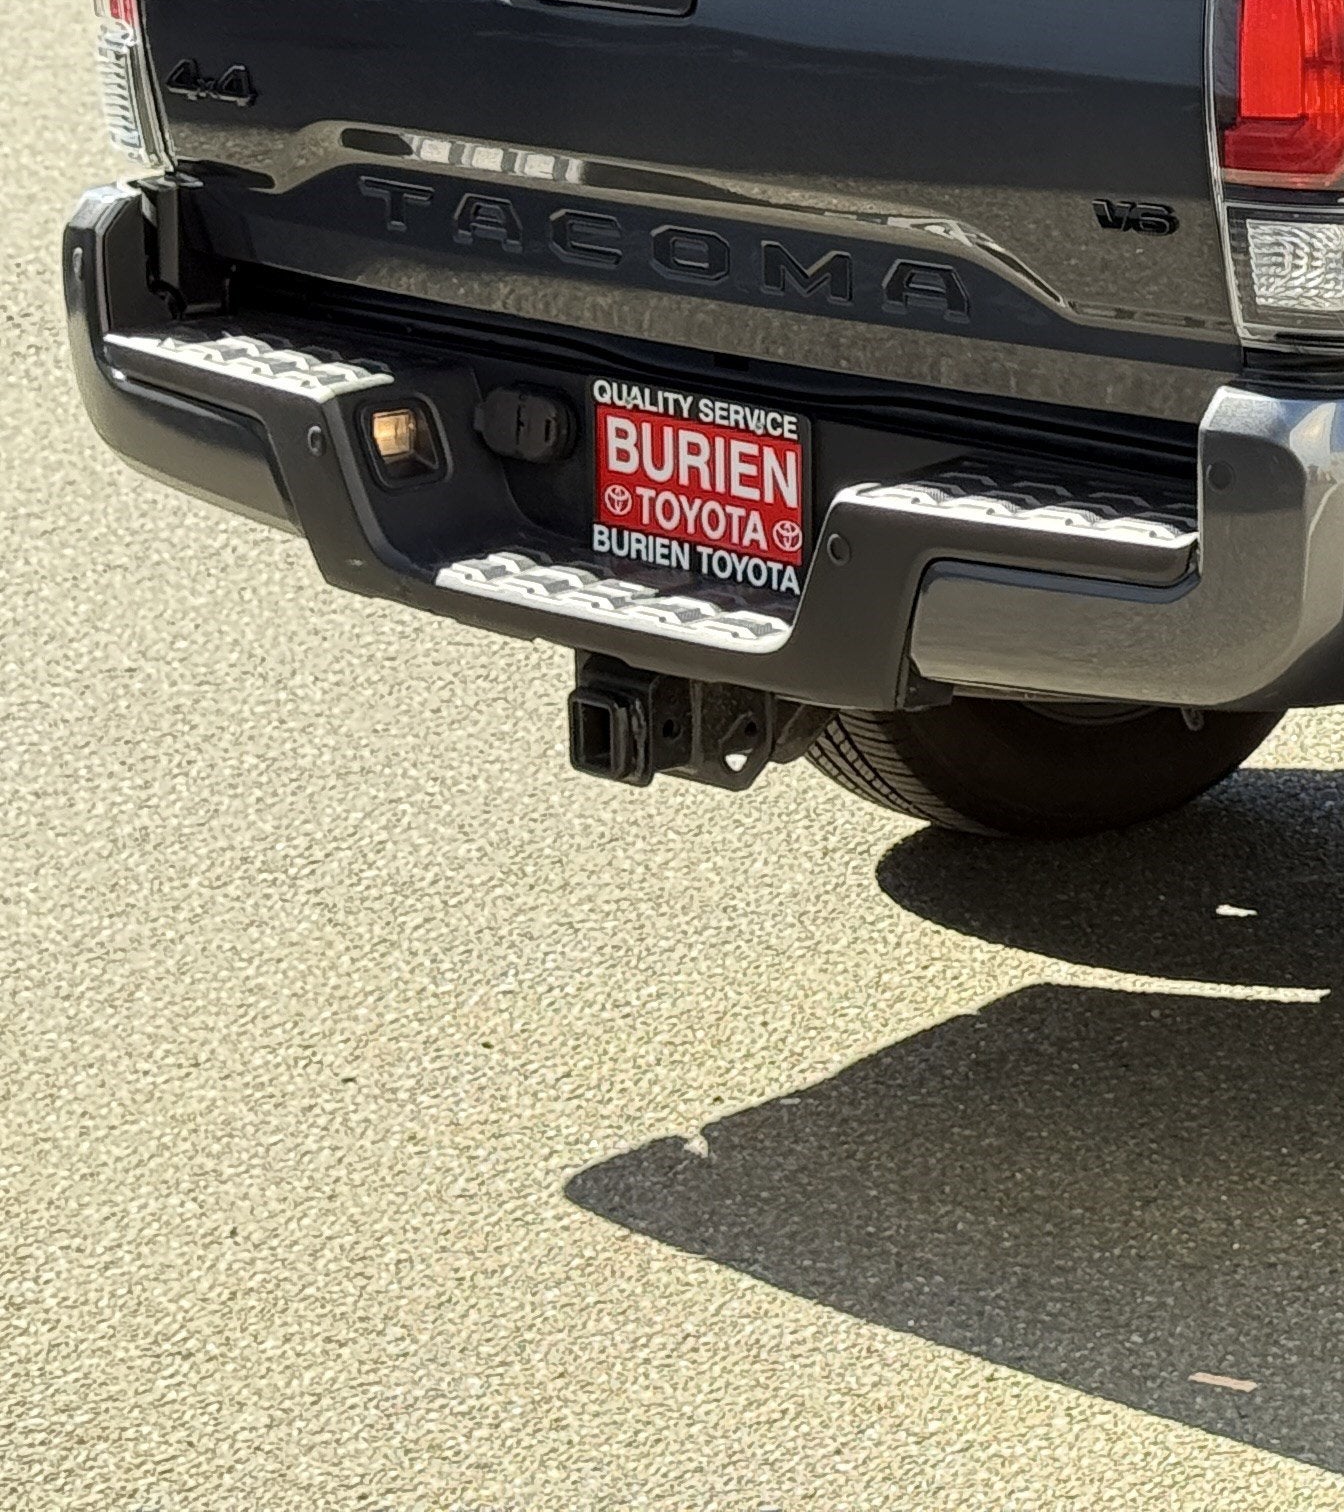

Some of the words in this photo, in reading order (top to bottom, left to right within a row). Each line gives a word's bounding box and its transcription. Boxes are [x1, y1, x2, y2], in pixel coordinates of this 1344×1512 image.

[359, 174, 973, 325] TACOMA
[1092, 199, 1180, 237] V6
[592, 379, 694, 419] QUALITY
[698, 398, 799, 440] SERVICE
[605, 414, 799, 509] BURIEN
[634, 486, 769, 551] TOYOTA
[592, 523, 691, 571] BURIEN
[696, 545, 801, 596] TOYOTA
